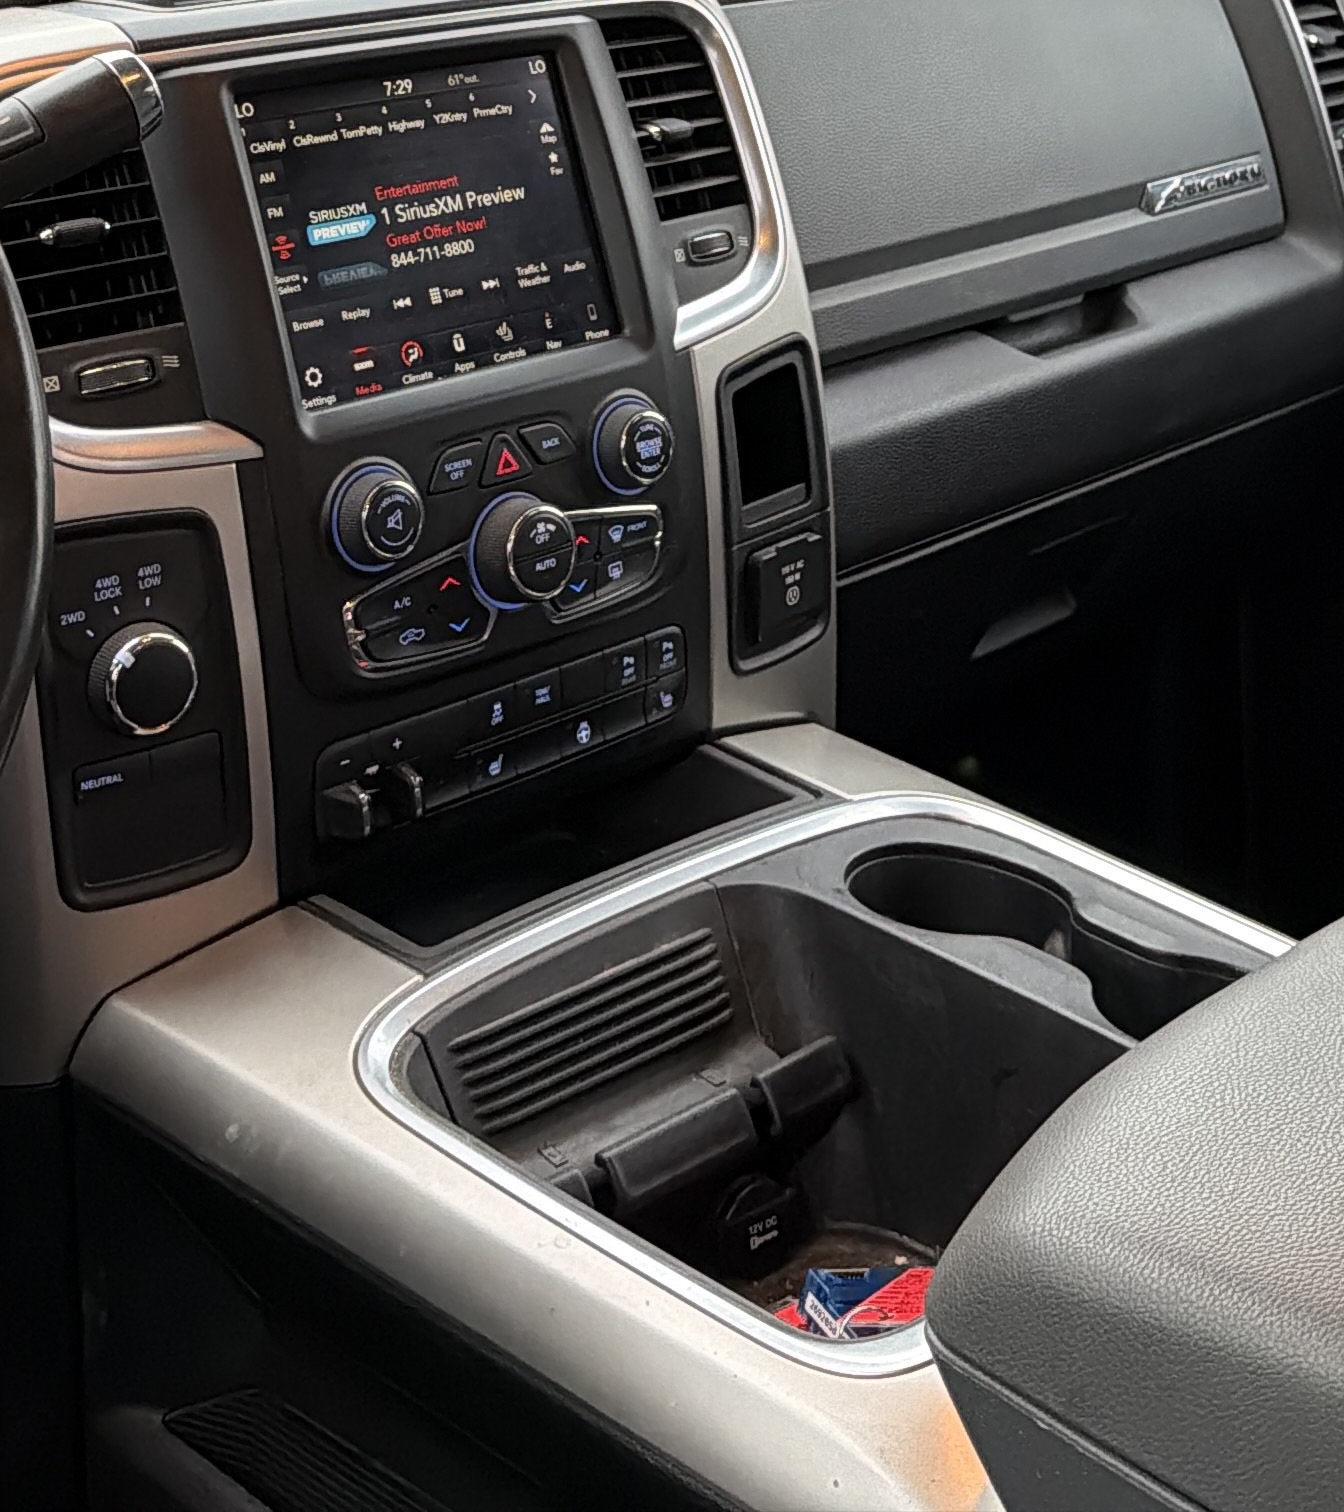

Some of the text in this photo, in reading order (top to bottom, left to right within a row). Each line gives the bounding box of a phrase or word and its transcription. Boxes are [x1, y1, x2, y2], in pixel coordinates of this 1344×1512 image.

[528, 59, 546, 75] LO
[383, 79, 413, 96] 7:29
[234, 102, 255, 119] LO
[340, 125, 383, 140] TomPetty
[259, 172, 276, 184] AM
[374, 175, 460, 201] Entertainment
[394, 193, 463, 223] SiriusXM
[465, 186, 525, 209] Preview
[267, 206, 284, 219] FM
[308, 202, 367, 224] SIRIUSXM
[386, 230, 421, 248] Great
[456, 216, 488, 233] Now!
[391, 238, 475, 268] 844-711-8800
[341, 307, 371, 321] Replay
[292, 318, 324, 332] Browse
[584, 329, 610, 341] Phone
[493, 348, 526, 363] Controls
[454, 361, 475, 374] Apps
[402, 371, 434, 385] Climate
[301, 394, 337, 410] Settings
[542, 438, 560, 450] BACK
[444, 458, 472, 472] SCREEN
[450, 470, 465, 481] OFF
[535, 533, 551, 544] OFF
[137, 563, 162, 577] 4WD
[535, 558, 557, 572] AUTO
[95, 575, 120, 589] 4WD
[138, 575, 162, 590] LOW
[94, 586, 123, 602] LOCK
[393, 596, 412, 610] A/C
[59, 610, 86, 626] 2WD
[80, 773, 124, 791] NEUTRAL
[765, 1215, 778, 1228] DC
